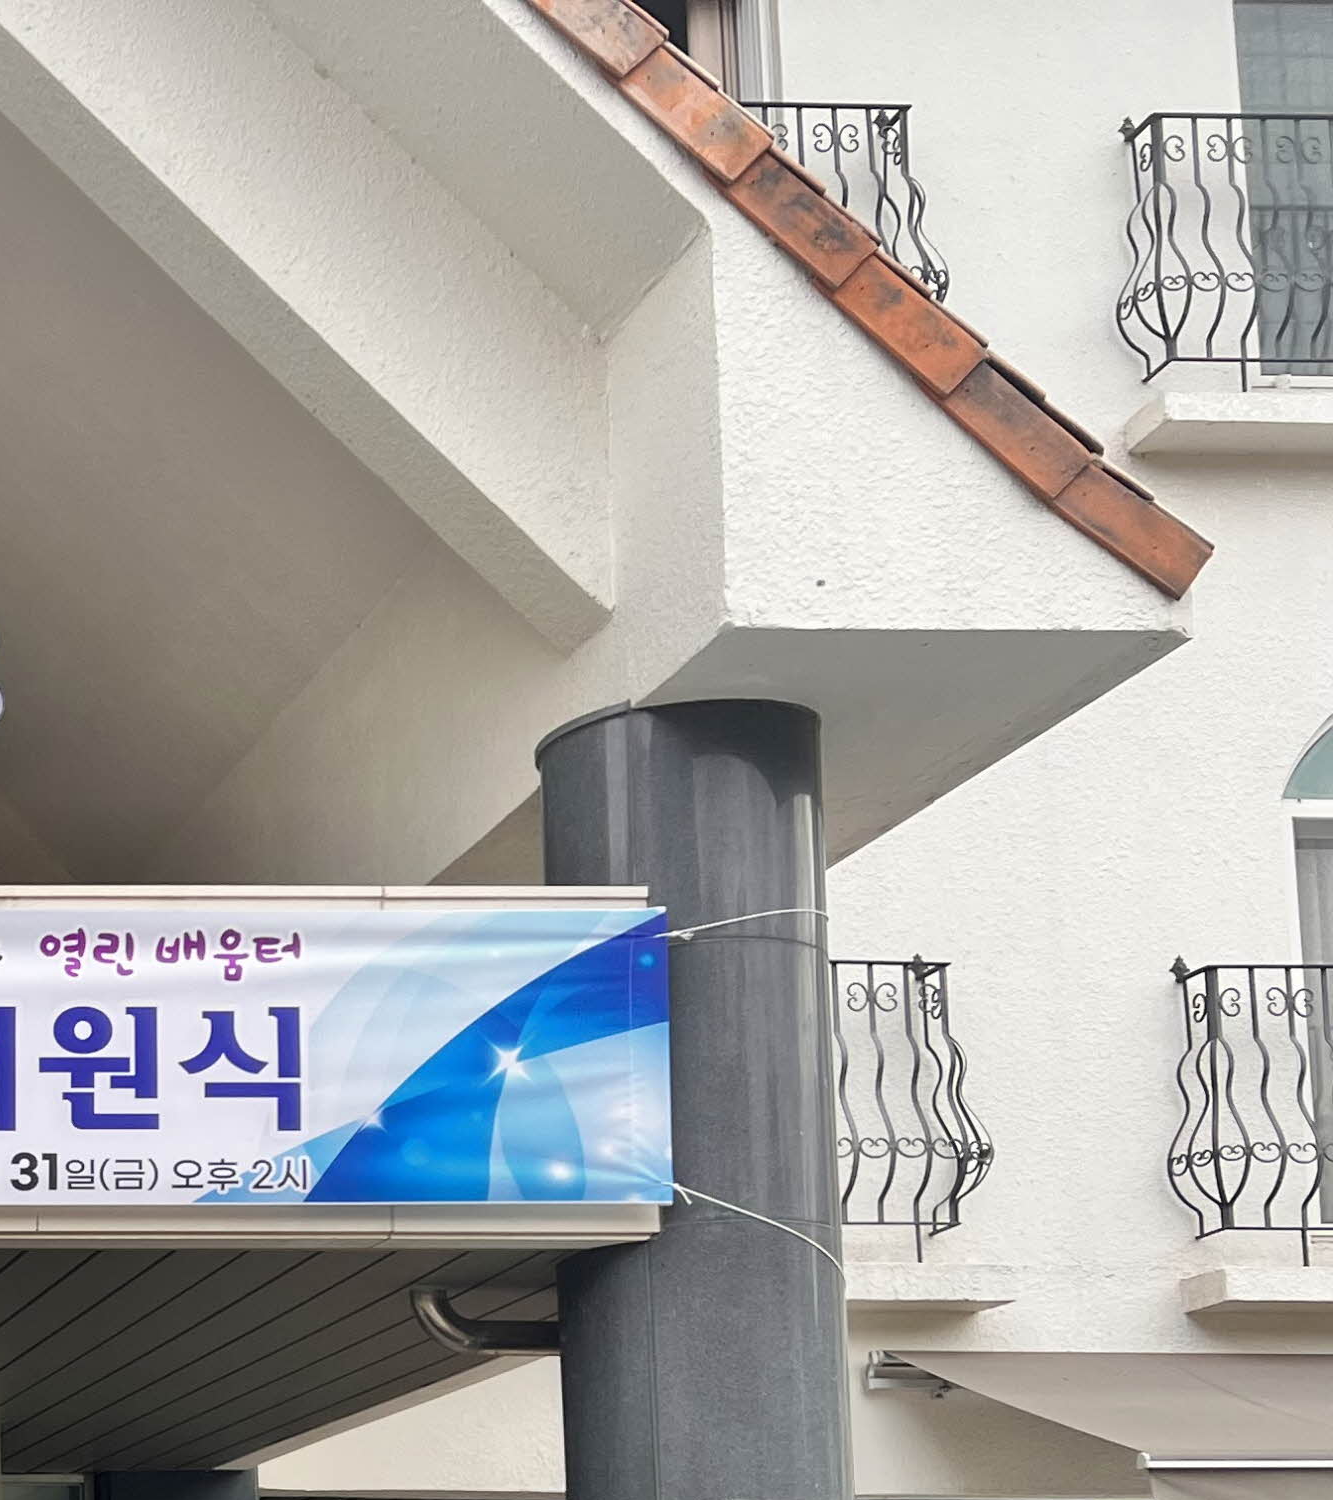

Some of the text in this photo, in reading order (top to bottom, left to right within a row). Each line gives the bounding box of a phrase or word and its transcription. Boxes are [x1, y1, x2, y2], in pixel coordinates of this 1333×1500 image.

[40, 928, 134, 977] 열린
[156, 929, 300, 981] 배움터
[11, 1152, 158, 1191] 31일(금)
[171, 1159, 239, 1190] 오후
[252, 1159, 307, 1190] 2시
